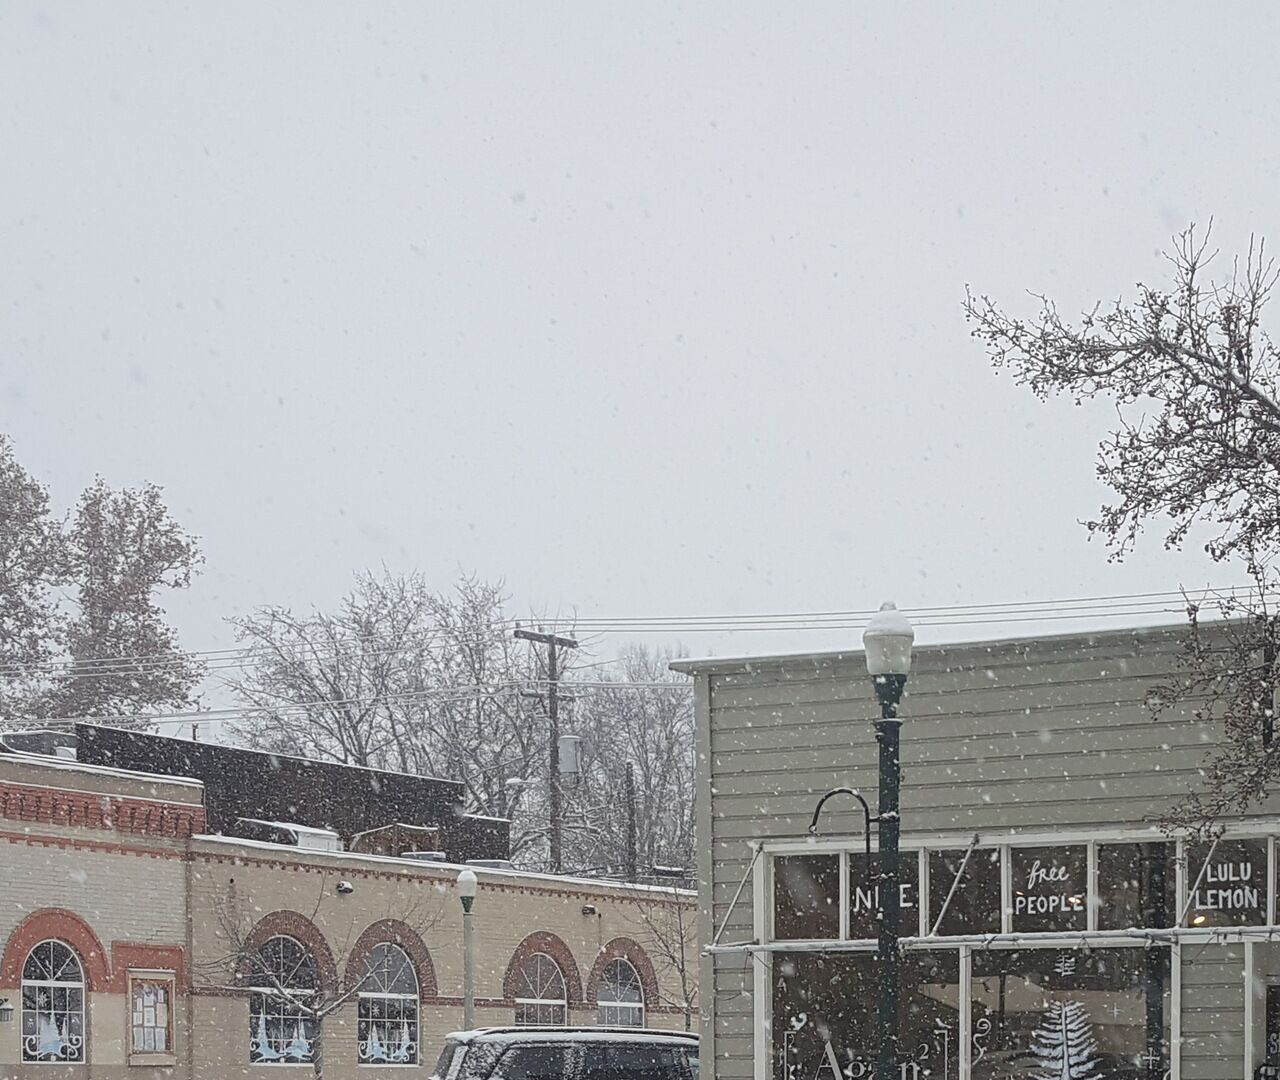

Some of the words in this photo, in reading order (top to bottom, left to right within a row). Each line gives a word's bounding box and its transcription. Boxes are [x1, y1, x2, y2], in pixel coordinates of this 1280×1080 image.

[1026, 859, 1070, 890] free
[1206, 861, 1252, 883] LULU
[853, 883, 914, 912] NIE
[1015, 893, 1085, 916] PEOPLE
[1194, 887, 1259, 911] LEMON
